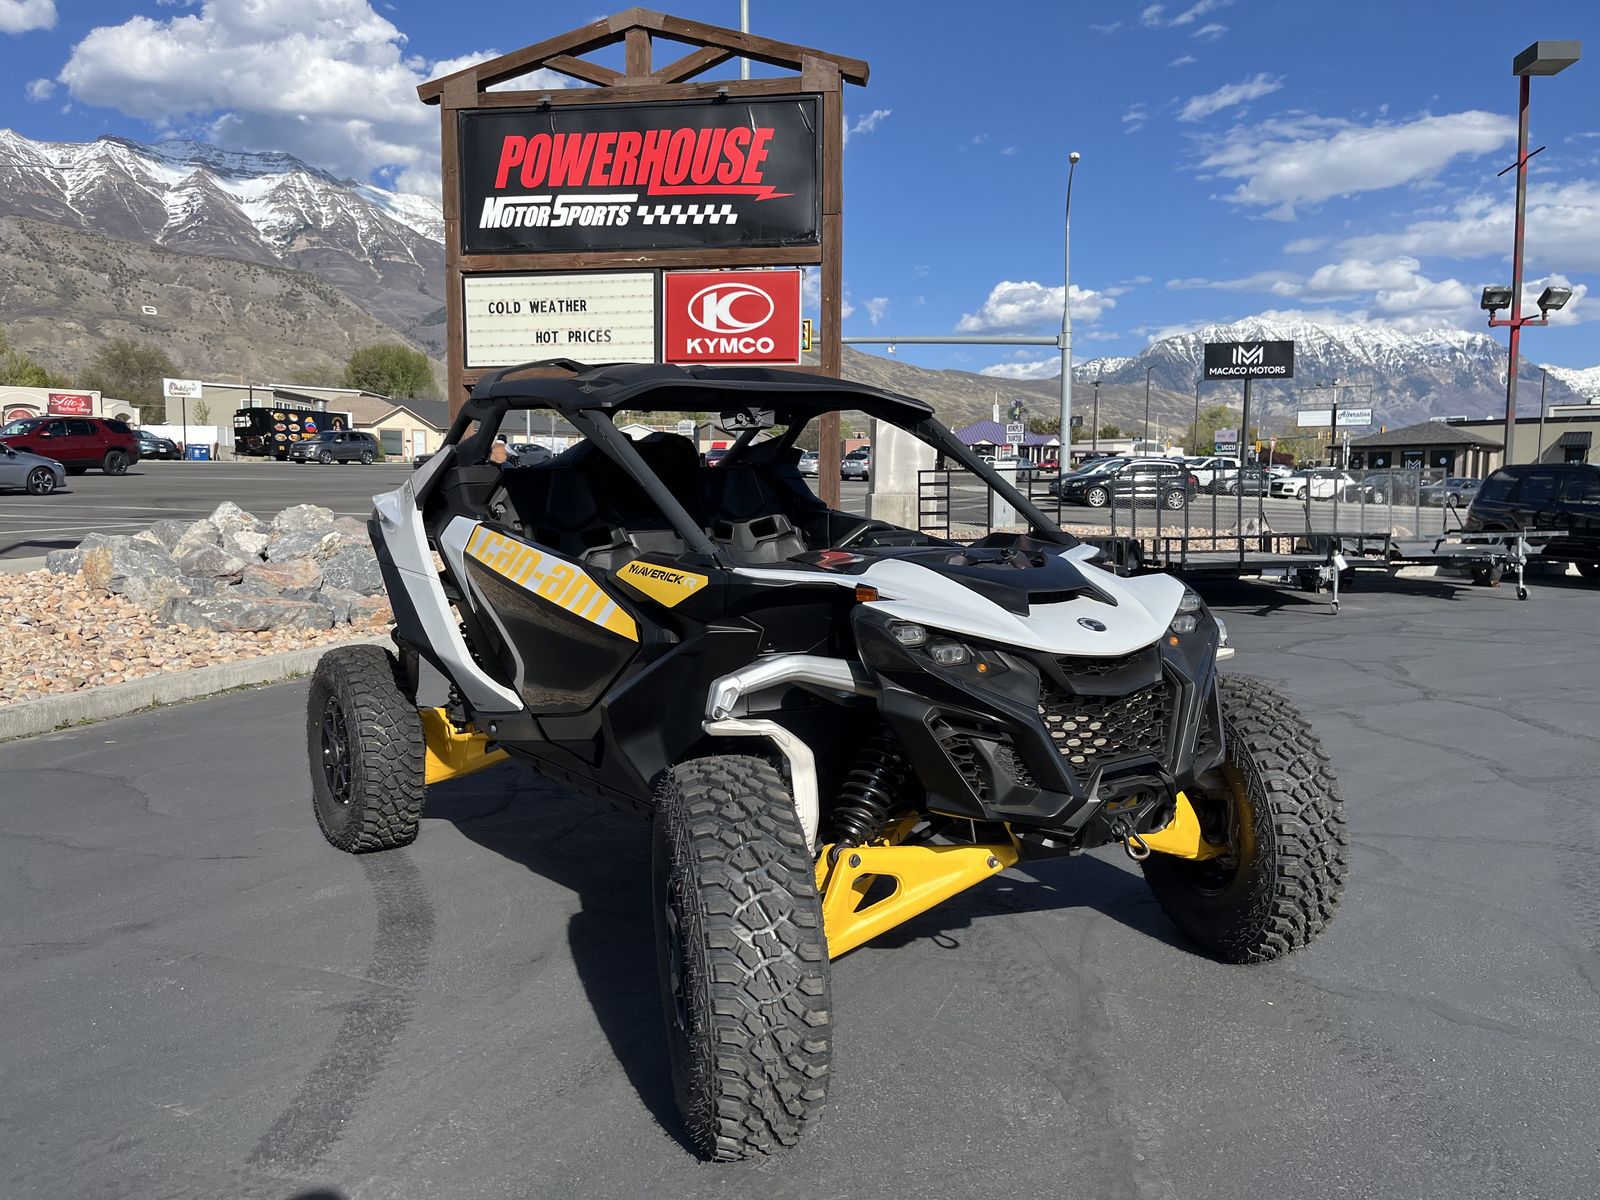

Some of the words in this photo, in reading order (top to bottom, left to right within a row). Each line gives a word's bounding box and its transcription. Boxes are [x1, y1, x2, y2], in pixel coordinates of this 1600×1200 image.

[494, 127, 776, 196] POWERHOUSE
[141, 305, 158, 315] G
[488, 301, 521, 315] COLD
[529, 299, 587, 314] WEATHER
[535, 331, 562, 344] HOT
[568, 329, 612, 344] PRICES
[686, 337, 775, 355] KYMCO
[1209, 366, 1248, 376] MACACO
[1249, 365, 1286, 375] MOTORS
[628, 564, 685, 585] MAVERICK
